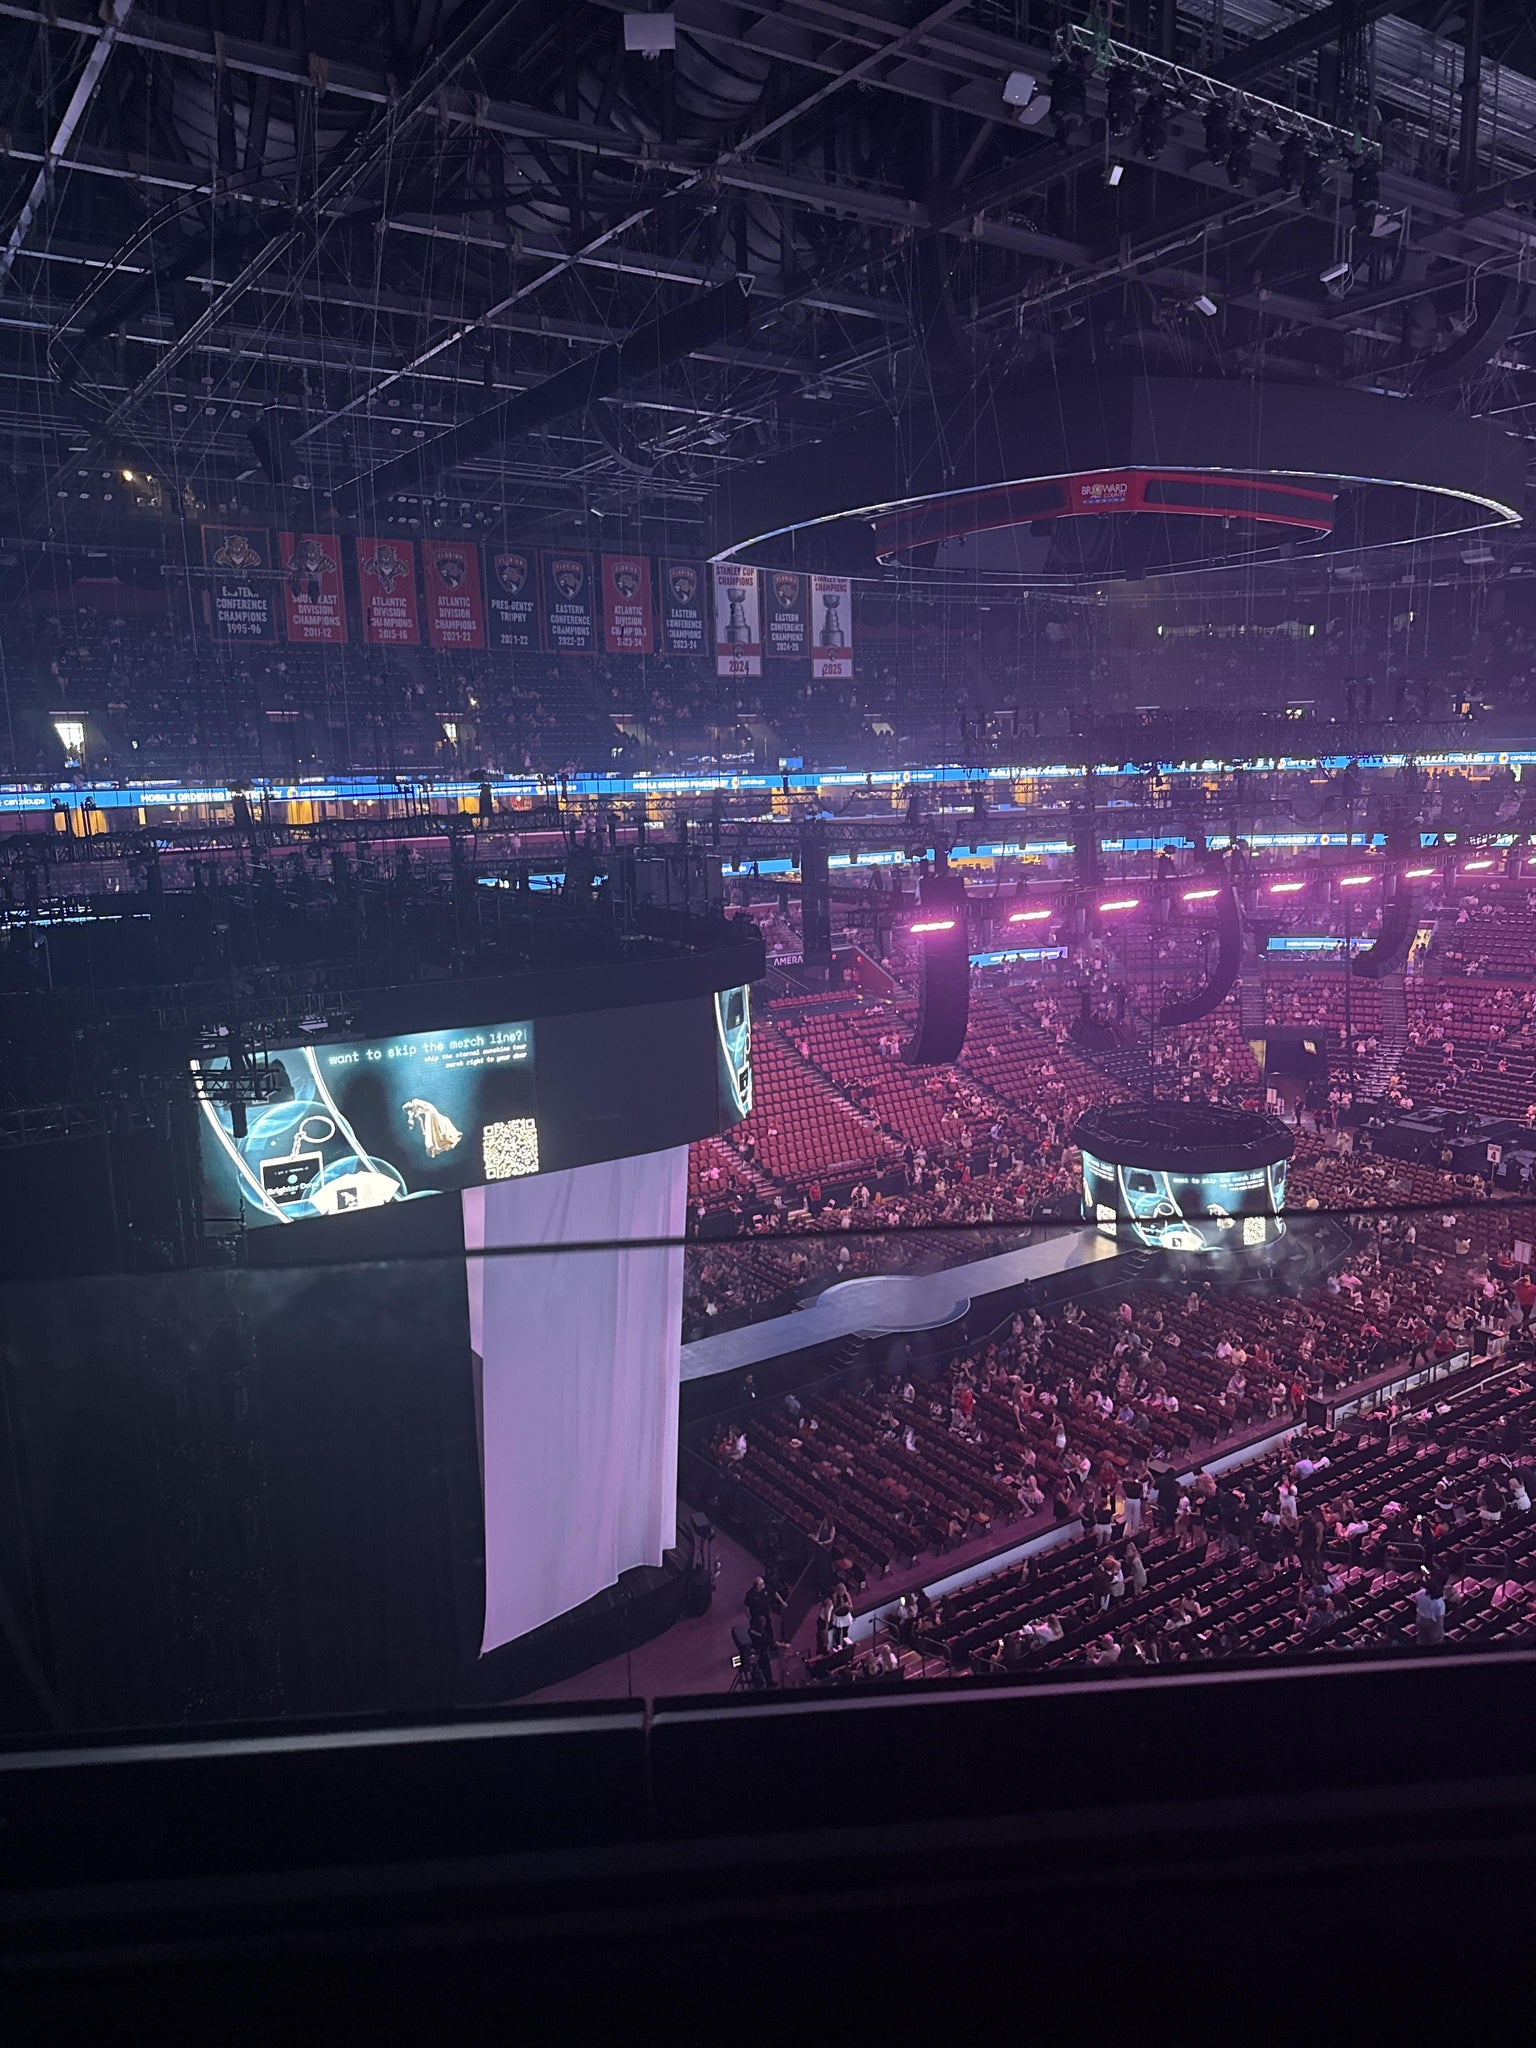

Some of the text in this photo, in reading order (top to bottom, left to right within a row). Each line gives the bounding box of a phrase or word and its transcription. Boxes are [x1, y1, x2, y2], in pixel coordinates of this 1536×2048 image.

[716, 565, 755, 577] STANLEY CUP
[718, 576, 754, 586] CHAMPIONS
[815, 583, 848, 592] CHAMPIONS
[216, 599, 268, 610] CONFERENCE
[371, 597, 407, 607] ATLANTIC
[437, 597, 471, 607] ATLANTIC
[298, 604, 334, 616] DIVISION
[373, 607, 407, 618] DIVISION
[439, 607, 471, 618] DIVISION
[555, 604, 585, 614] EASTERN
[614, 605, 643, 616] ATLANTIC
[671, 608, 697, 618] EASTERN
[218, 611, 268, 622] CHAMPIONS
[292, 615, 341, 626] CHAMPIONS
[550, 614, 591, 625] CONFERENCE
[615, 616, 642, 626] DIVISION
[775, 613, 799, 623] EASTERN
[226, 623, 262, 634] 1995-96
[434, 619, 477, 630] CHAMPIONS
[770, 623, 804, 632] CONFERENCE
[303, 627, 333, 638] 2011-12
[378, 629, 408, 640] 2015-16
[552, 625, 590, 636] CHAMPIONS
[668, 629, 702, 640] CHAMPIONS
[442, 631, 472, 642] 2021-22
[558, 637, 585, 647] 2022-23
[771, 632, 804, 642] CHAMPIONS
[672, 639, 698, 649] 2023-24
[776, 642, 799, 652] 2024-25
[729, 660, 749, 673] 2024
[823, 663, 842, 675] 2025
[140, 792, 176, 803] MOBILE
[177, 790, 225, 802] ORDERING
[1273, 837, 1307, 845] POWERED
[328, 1030, 524, 1066] want to skip the merch line?
[442, 1053, 453, 1061] the
[466, 1057, 484, 1067] right
[1202, 1177, 1218, 1185] skip
[266, 1184, 300, 1197] Brighter
